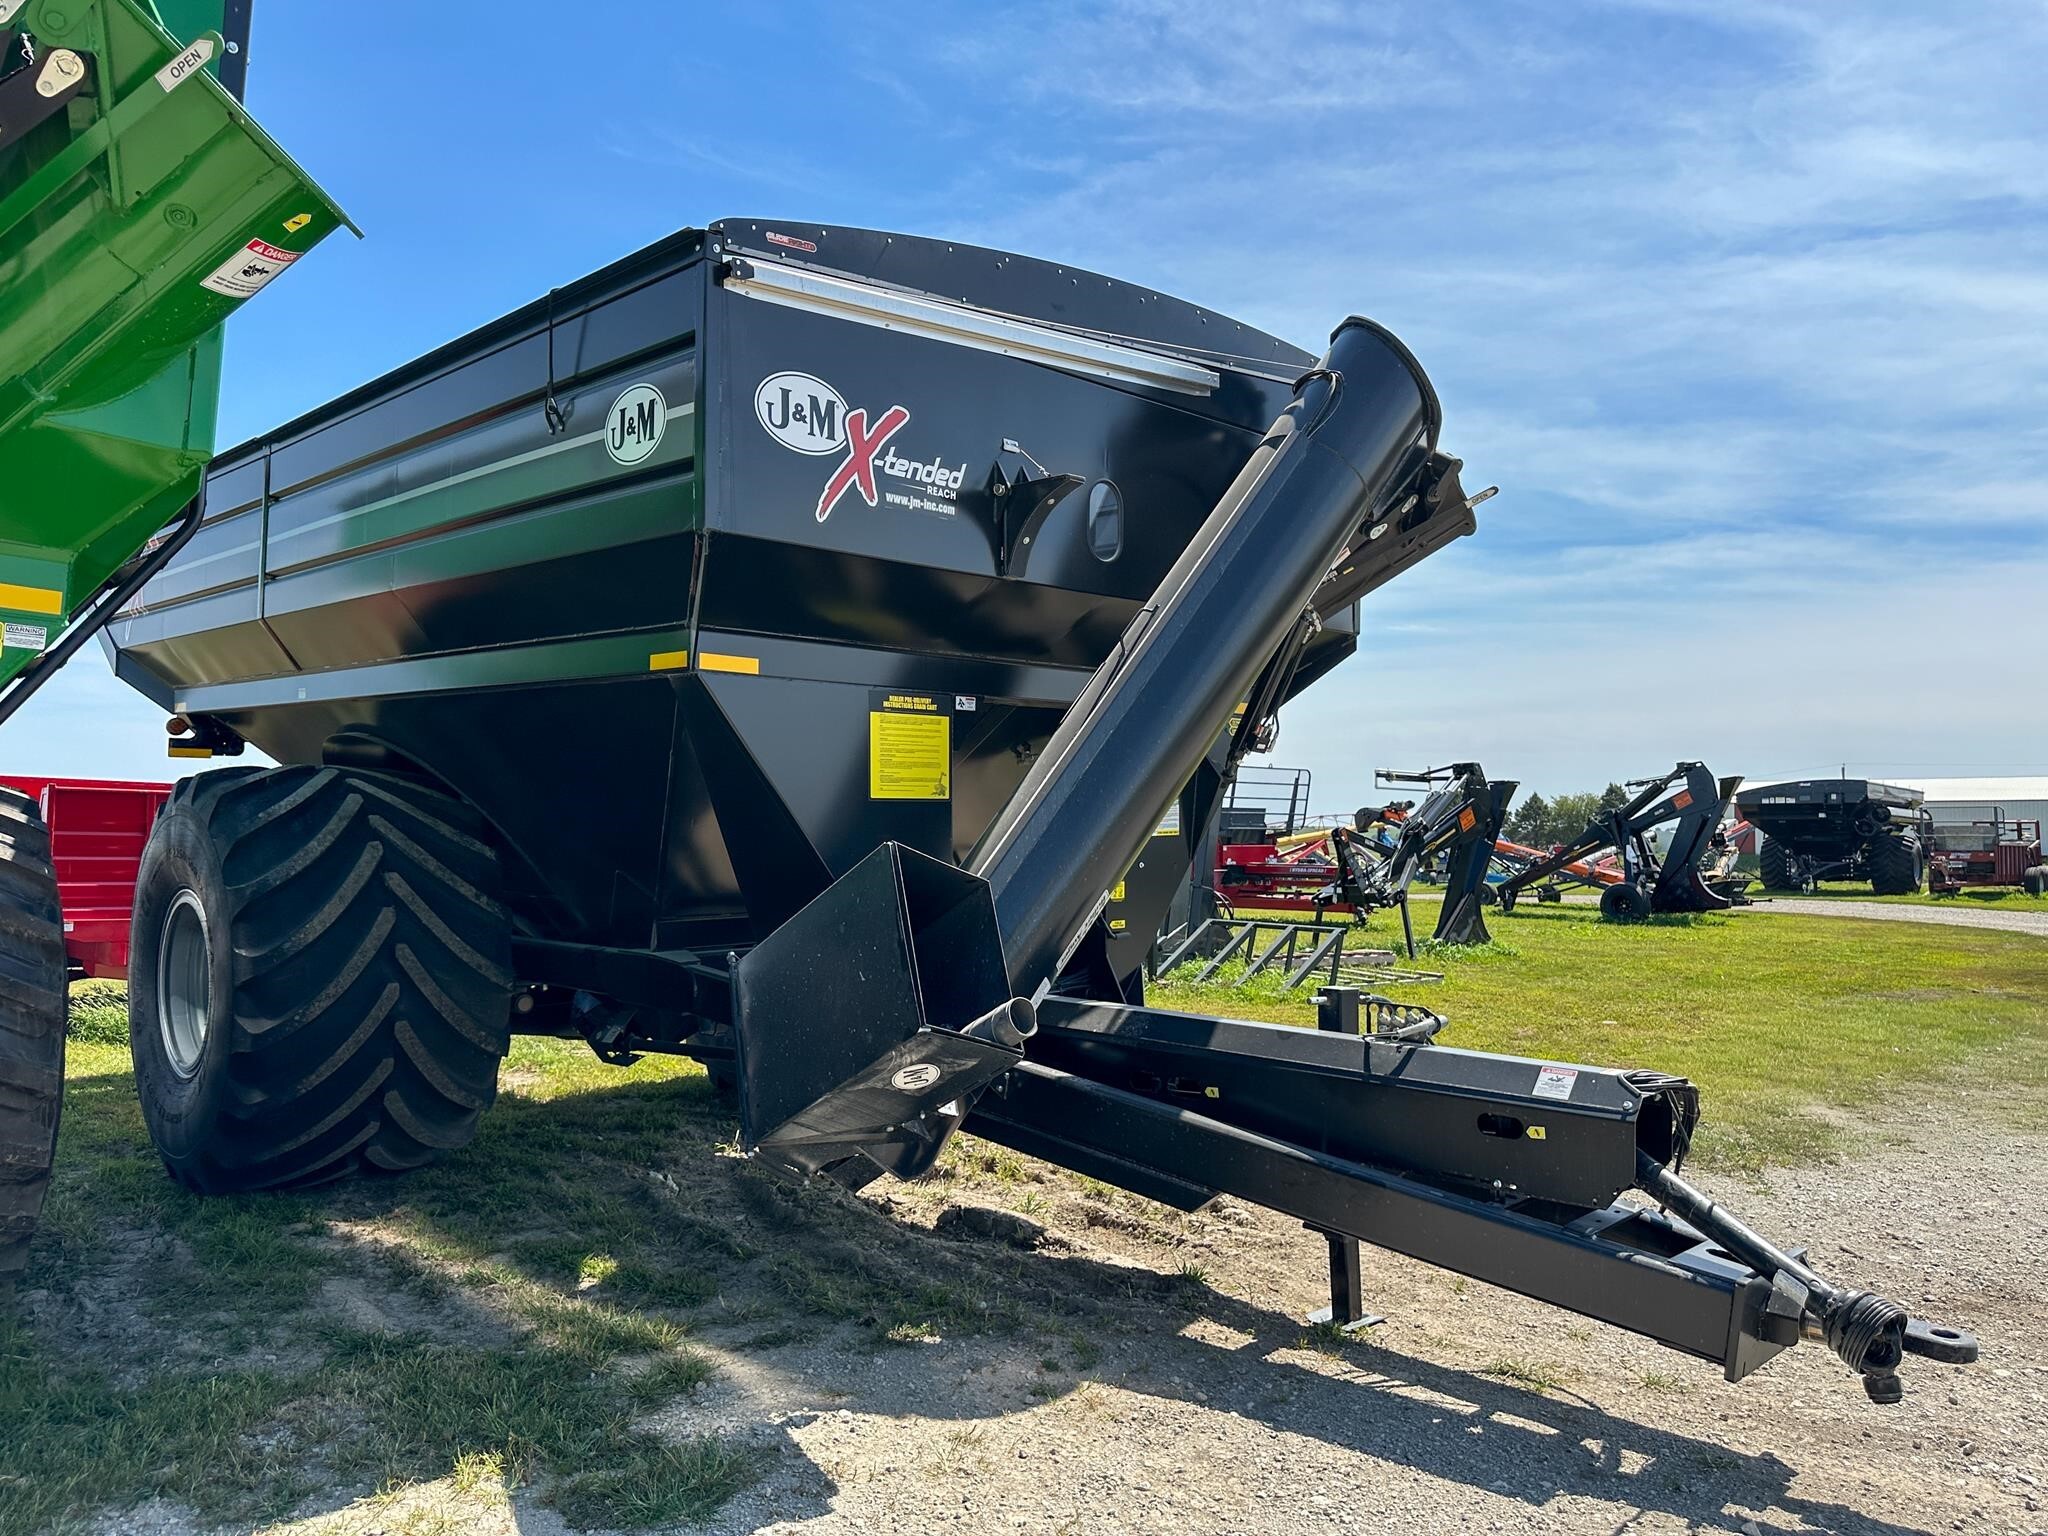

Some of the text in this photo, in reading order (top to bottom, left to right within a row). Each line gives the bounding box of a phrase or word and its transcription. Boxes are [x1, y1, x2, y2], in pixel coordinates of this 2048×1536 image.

[170, 49, 202, 78] OPEN
[611, 398, 656, 450] J&M
[766, 387, 837, 442] J&M
[885, 492, 955, 515] www.jm-inc.com
[927, 485, 957, 500] REACH
[1472, 493, 1488, 503] OPEN
[8, 625, 44, 635] WARNING
